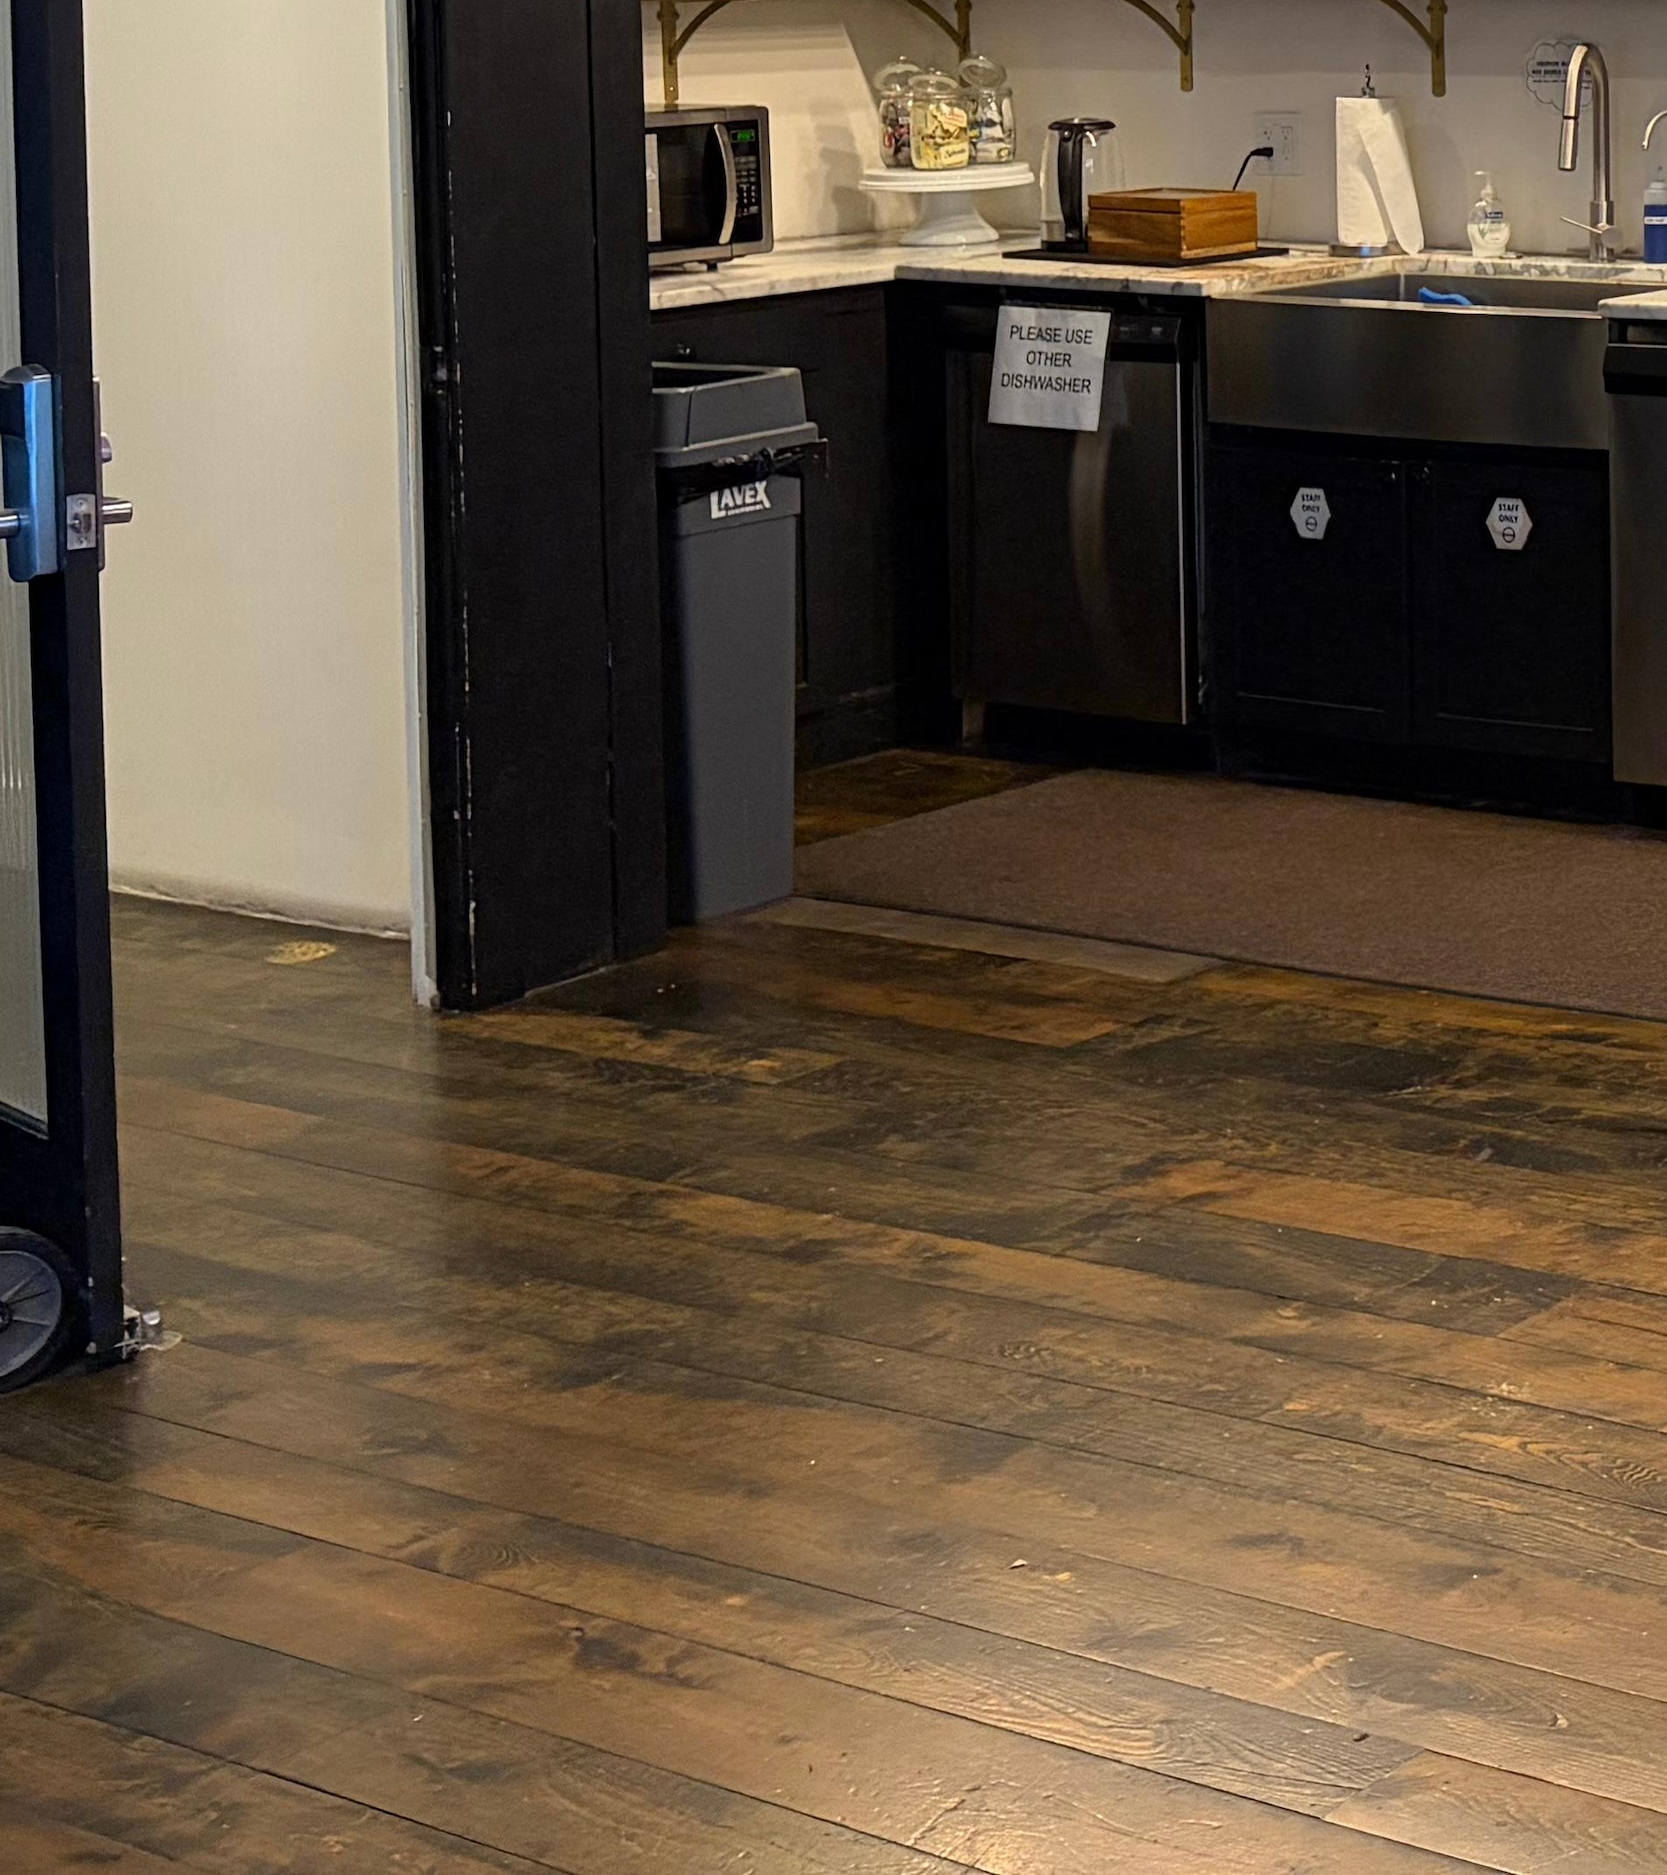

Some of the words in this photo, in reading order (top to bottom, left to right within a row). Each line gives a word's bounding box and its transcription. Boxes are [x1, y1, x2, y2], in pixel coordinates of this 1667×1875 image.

[1010, 325, 1062, 342] PLEASE
[1065, 329, 1093, 344] USE
[1026, 350, 1072, 368] OTHER
[1001, 373, 1092, 394] DISHWASHER
[710, 480, 771, 519] LAVEX
[1302, 504, 1320, 512] ONLY
[1499, 514, 1518, 523] ONLY
